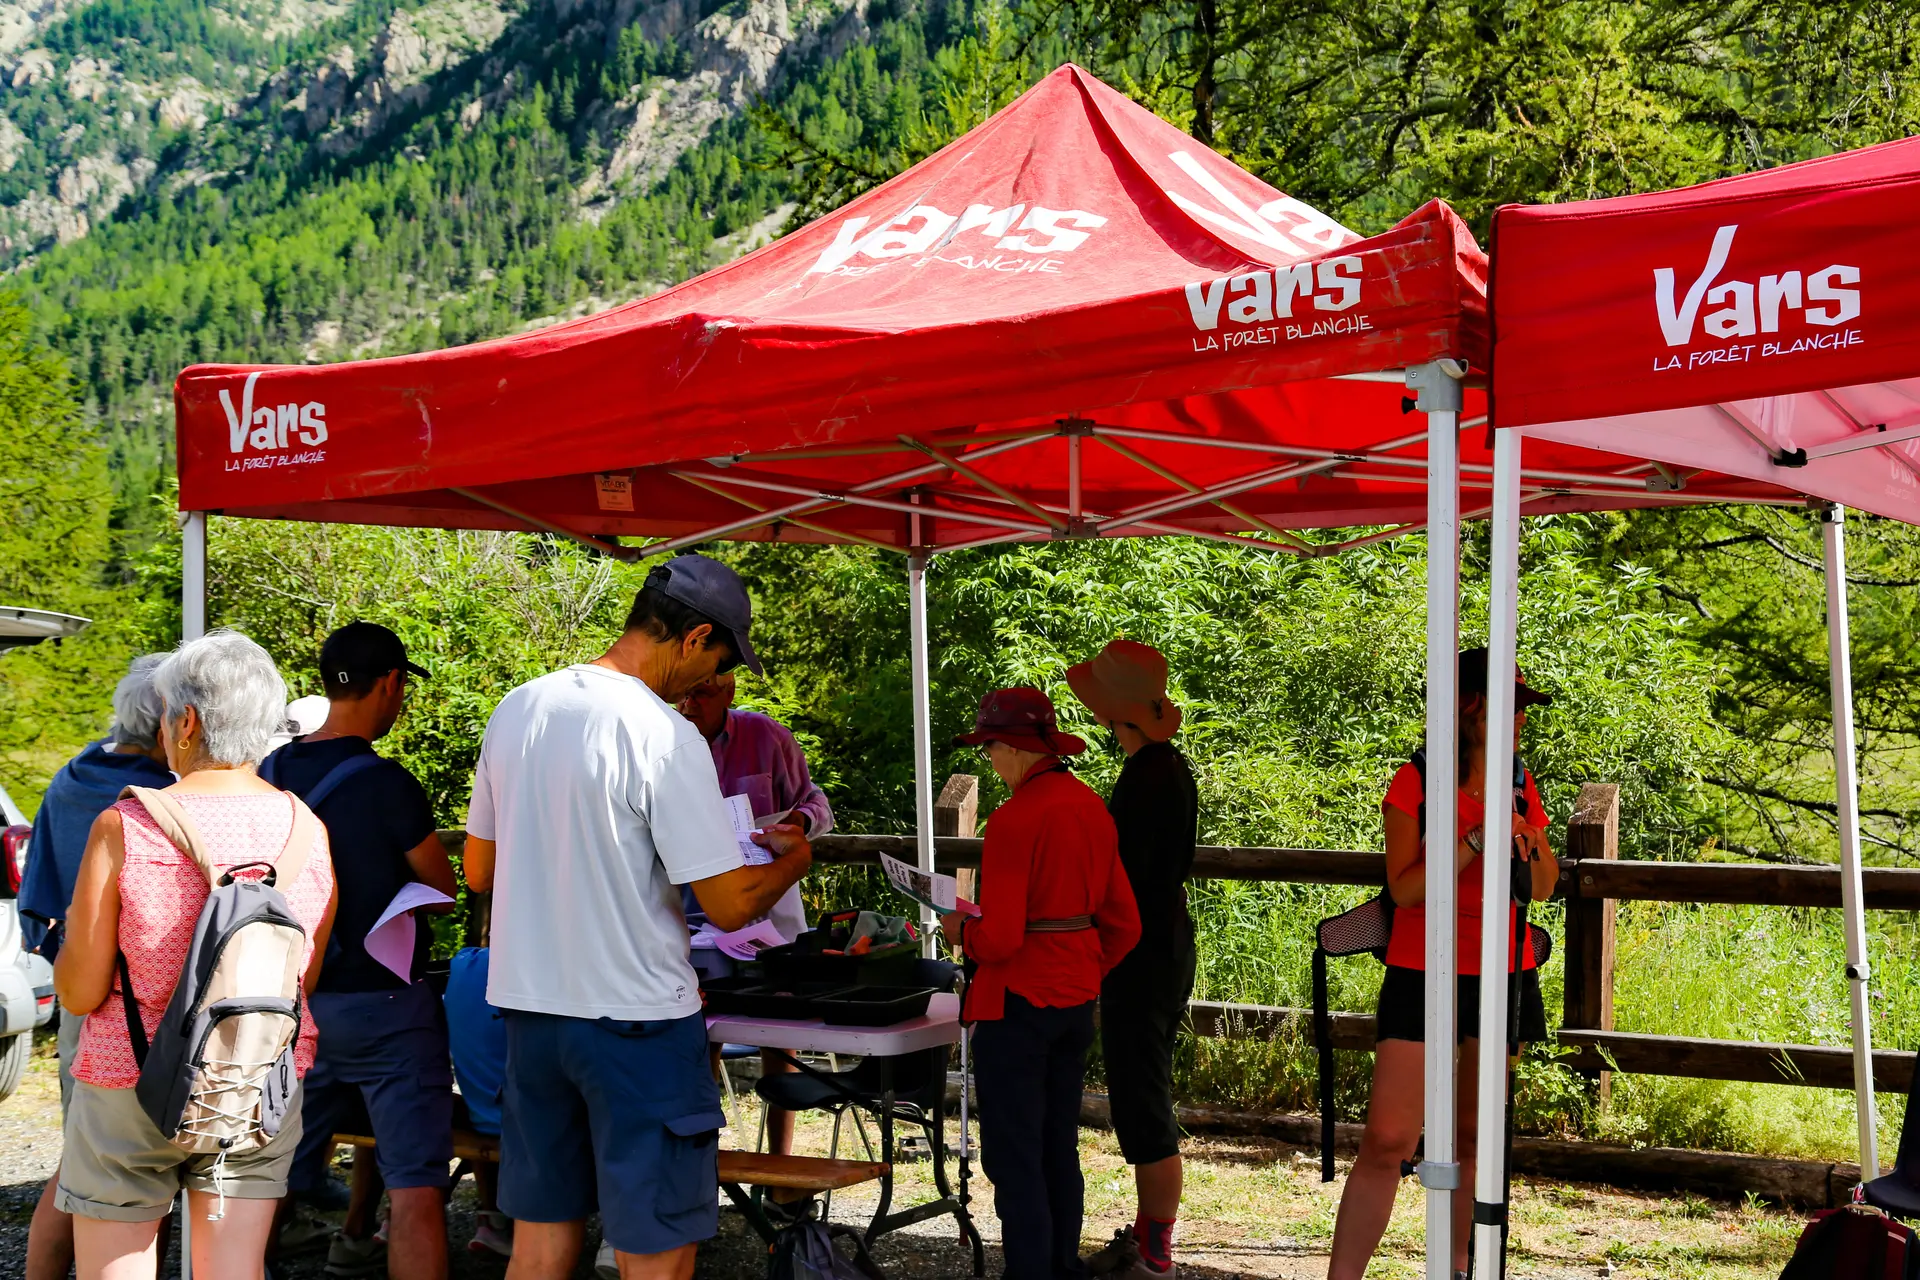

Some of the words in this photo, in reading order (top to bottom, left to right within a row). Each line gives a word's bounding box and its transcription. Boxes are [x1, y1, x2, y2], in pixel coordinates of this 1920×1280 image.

[808, 180, 1108, 273] Vars
[1166, 151, 1366, 257] Va
[1184, 255, 1364, 331] Vars
[1653, 224, 1861, 347] Vars
[1193, 335, 1219, 352] LA
[1223, 327, 1280, 351] FORÊT
[1286, 314, 1374, 341] BLANCHE
[1653, 355, 1682, 372] LA
[1688, 344, 1756, 371] FORÊT
[1761, 328, 1865, 357] BLANCHE
[218, 371, 329, 453] Vars
[225, 460, 240, 472] LA
[241, 455, 277, 472] FORÊT
[277, 449, 327, 466] BLANCHE
